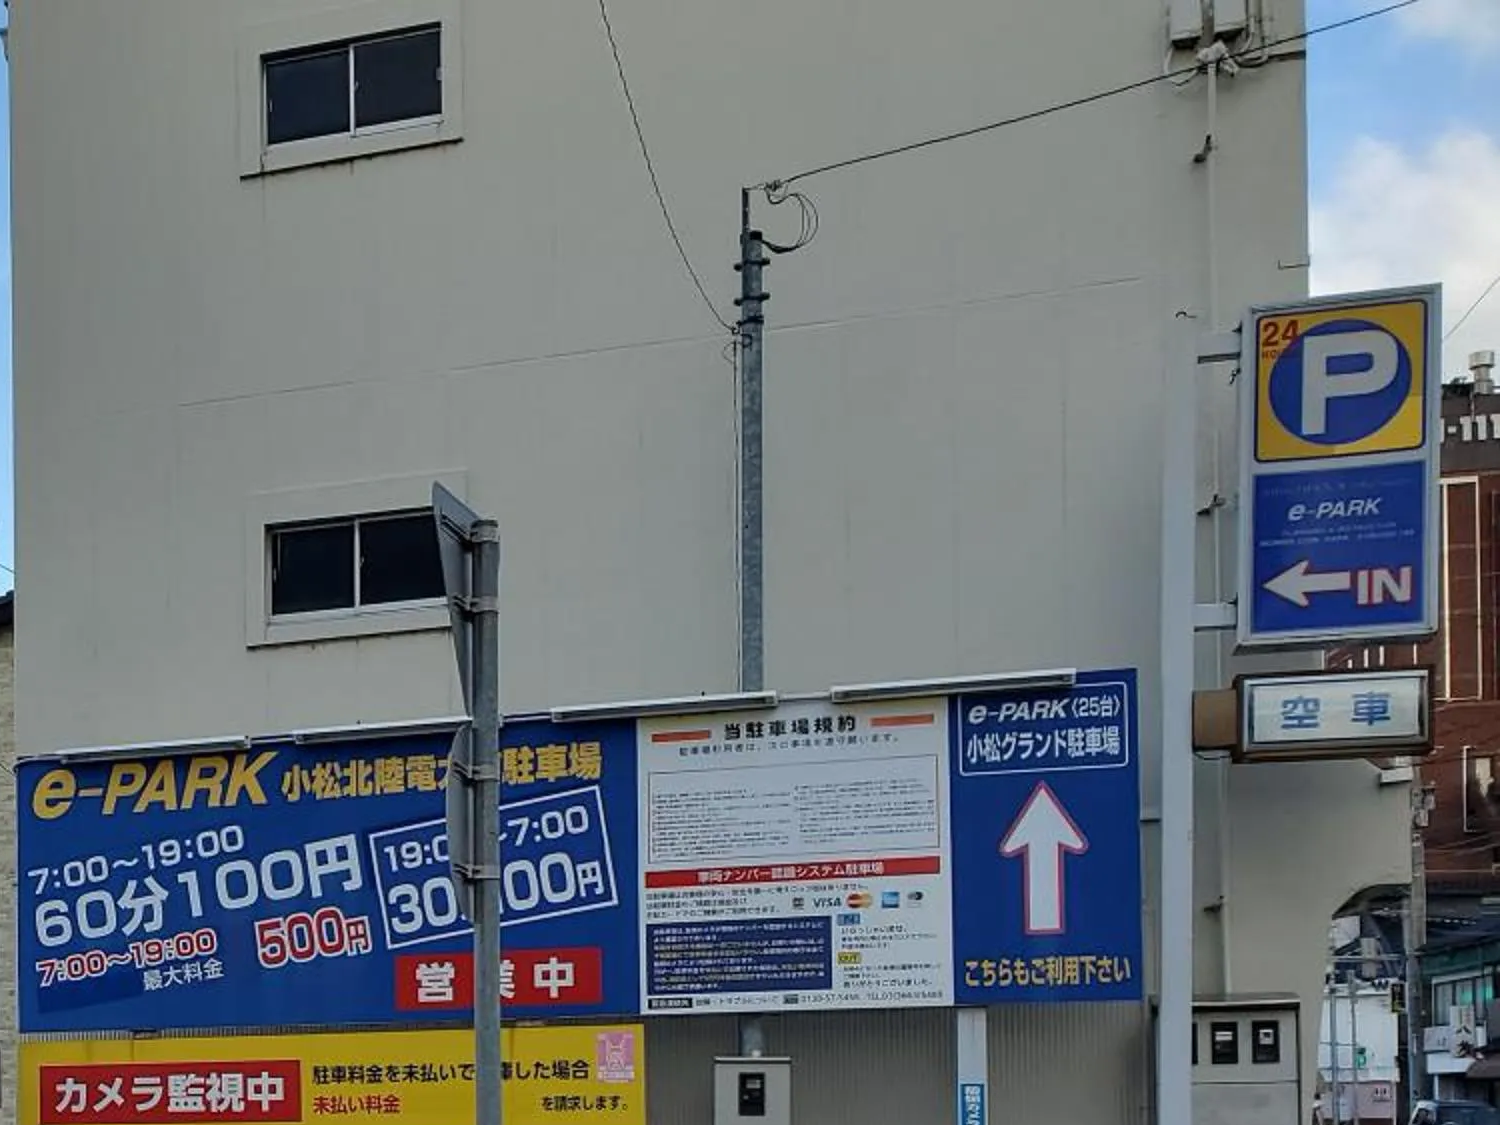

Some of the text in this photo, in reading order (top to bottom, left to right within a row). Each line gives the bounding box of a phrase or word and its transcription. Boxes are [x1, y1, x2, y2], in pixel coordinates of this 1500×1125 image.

[1301, 328, 1400, 436] P
[1288, 497, 1383, 521] e-PARK
[1356, 565, 1412, 605] IN
[724, 715, 857, 740] 当駐車場規約
[968, 698, 1070, 724] e-PARK
[1279, 690, 1392, 730] 空車
[967, 725, 1121, 763] 小松グランド駐車場
[32, 751, 280, 819] e-PARK
[813, 897, 842, 908] VISA
[255, 906, 373, 969] 500円
[143, 957, 225, 992] 最大料金
[964, 955, 1132, 987] こちらもご利用下さい
[55, 1071, 285, 1113] カメラ監視中
[313, 1094, 401, 1116] 未払い料金
